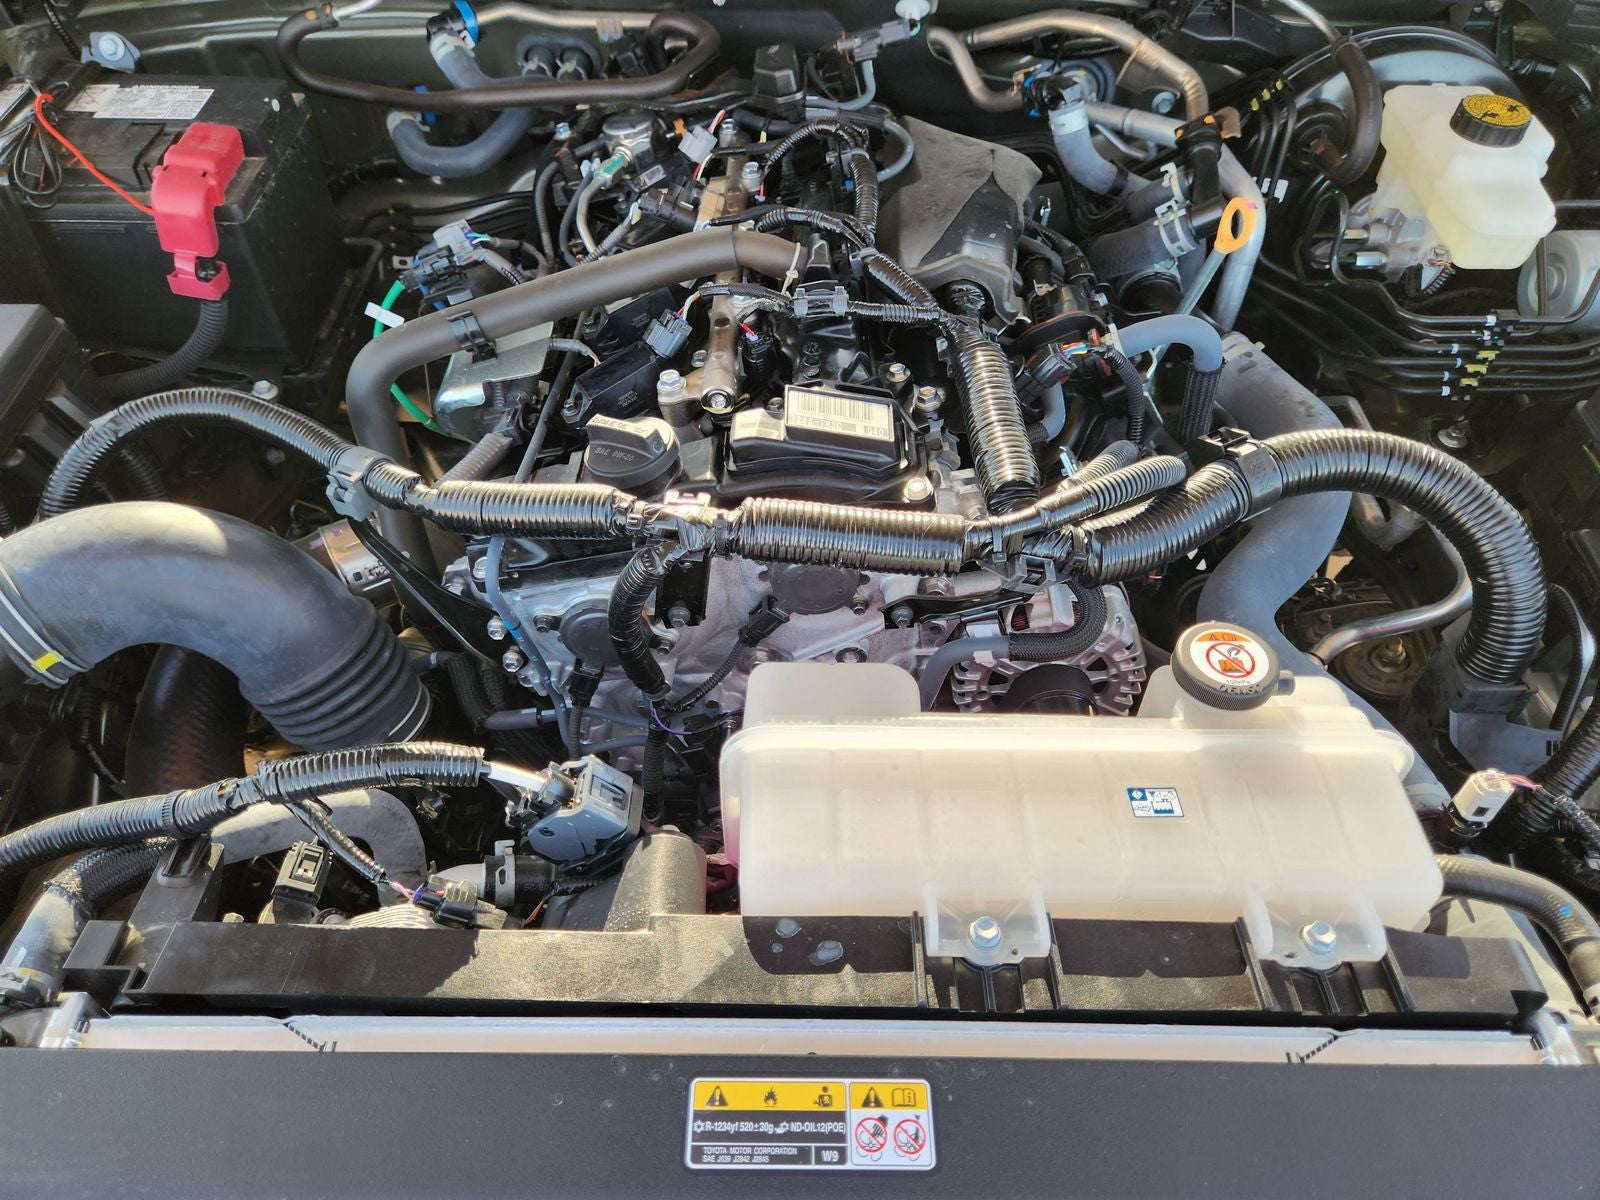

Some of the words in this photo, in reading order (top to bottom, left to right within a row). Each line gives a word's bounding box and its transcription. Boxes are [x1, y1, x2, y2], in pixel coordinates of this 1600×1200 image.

[594, 447, 611, 457] SAE
[612, 451, 636, 463] 0W-20
[705, 1121, 739, 1134] R-1234yf
[790, 1121, 846, 1134] ND-OIL12(POE)
[703, 1146, 727, 1155] TOYOTA
[729, 1146, 752, 1155] MOTOR
[753, 1146, 798, 1155] CORPORATION
[821, 1150, 839, 1162] W9
[702, 1155, 715, 1163] SAE
[732, 1155, 750, 1163] J2842
